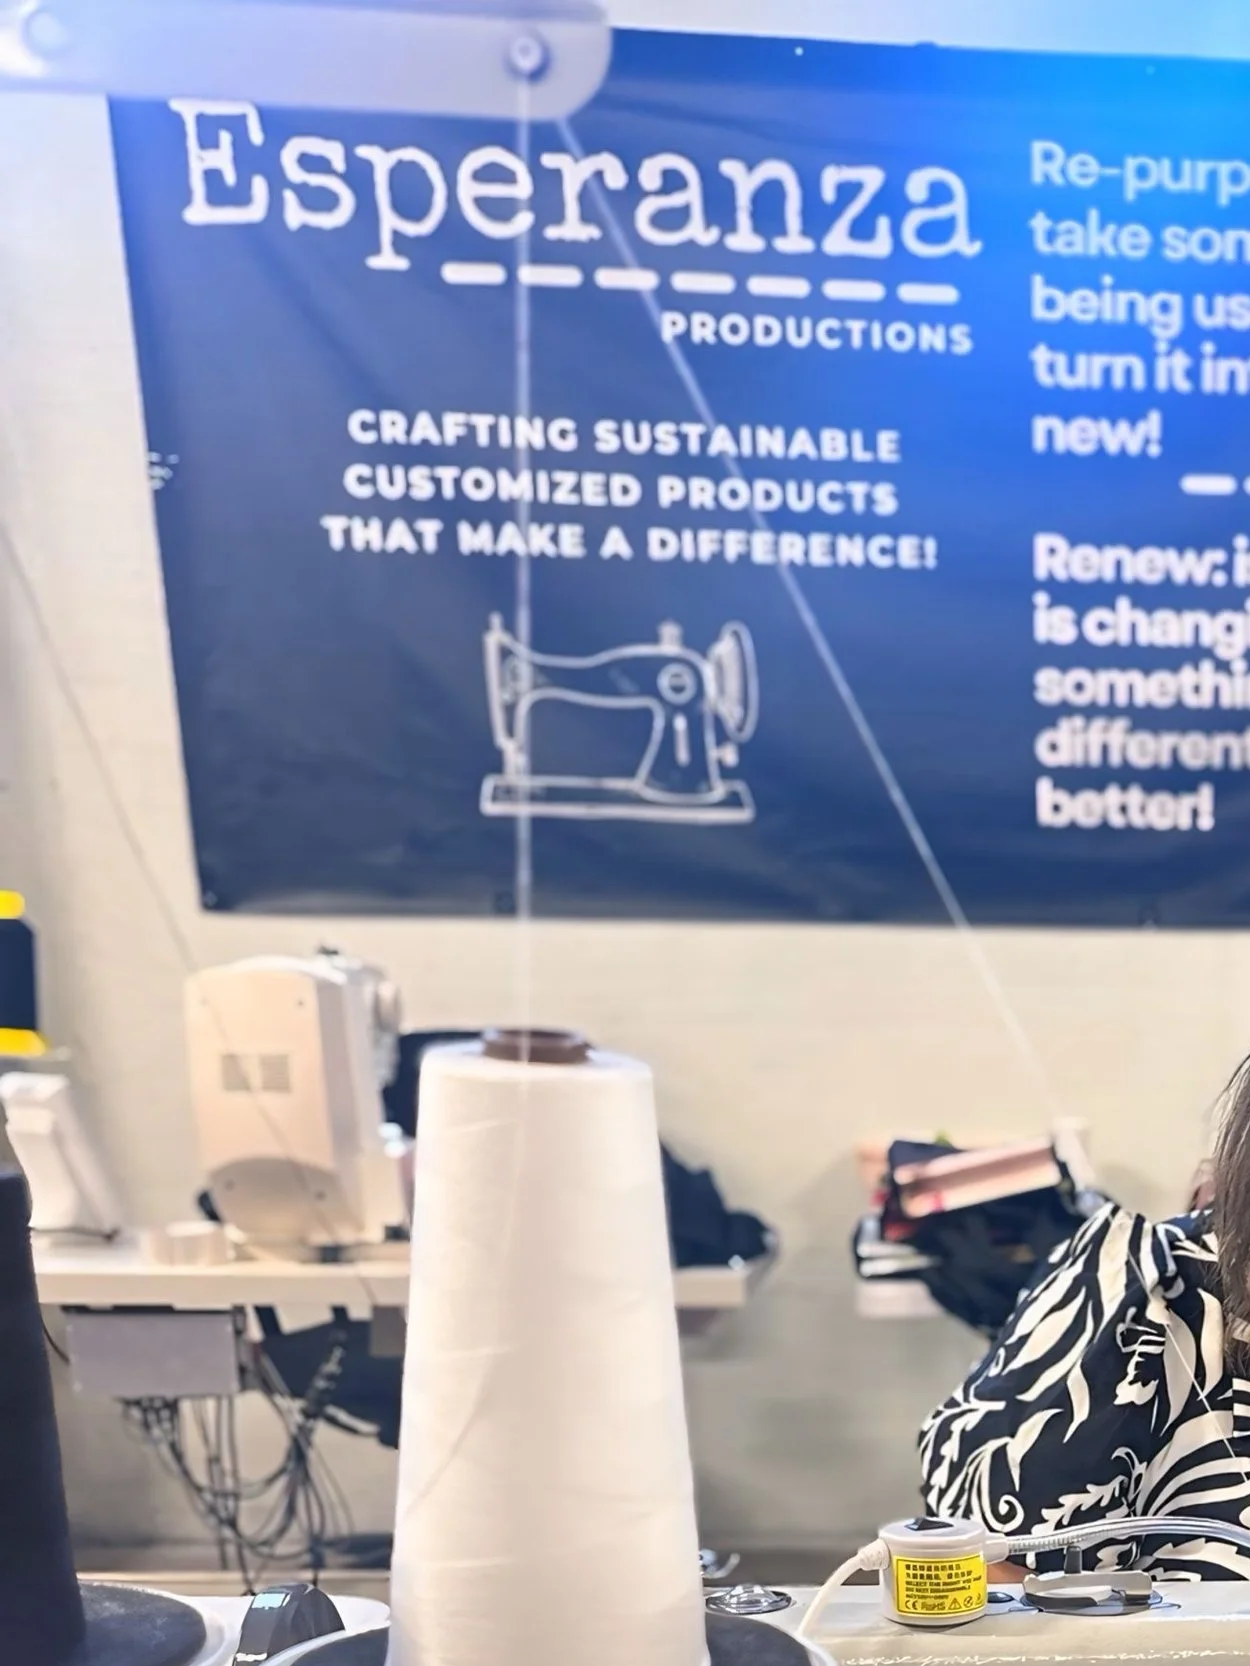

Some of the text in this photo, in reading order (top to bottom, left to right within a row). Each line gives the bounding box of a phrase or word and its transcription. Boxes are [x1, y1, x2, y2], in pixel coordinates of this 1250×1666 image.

[171, 98, 983, 270] Esperanza
[1030, 210, 1152, 257] take
[661, 311, 973, 355] PRODUCTIONS
[1031, 275, 1182, 337] being
[1030, 342, 1145, 391] turn
[1154, 339, 1191, 394] it
[347, 408, 901, 463] CRAFTING SUSTAINABLE
[1031, 409, 1163, 459] new!
[343, 463, 899, 516] CUSTOMIZED PRODUCTS
[321, 516, 939, 571] THAT MAKE A DIFFERENCE!
[1032, 532, 1228, 588] Renew:
[1032, 592, 1079, 645] is
[1035, 776, 1215, 831] better!
